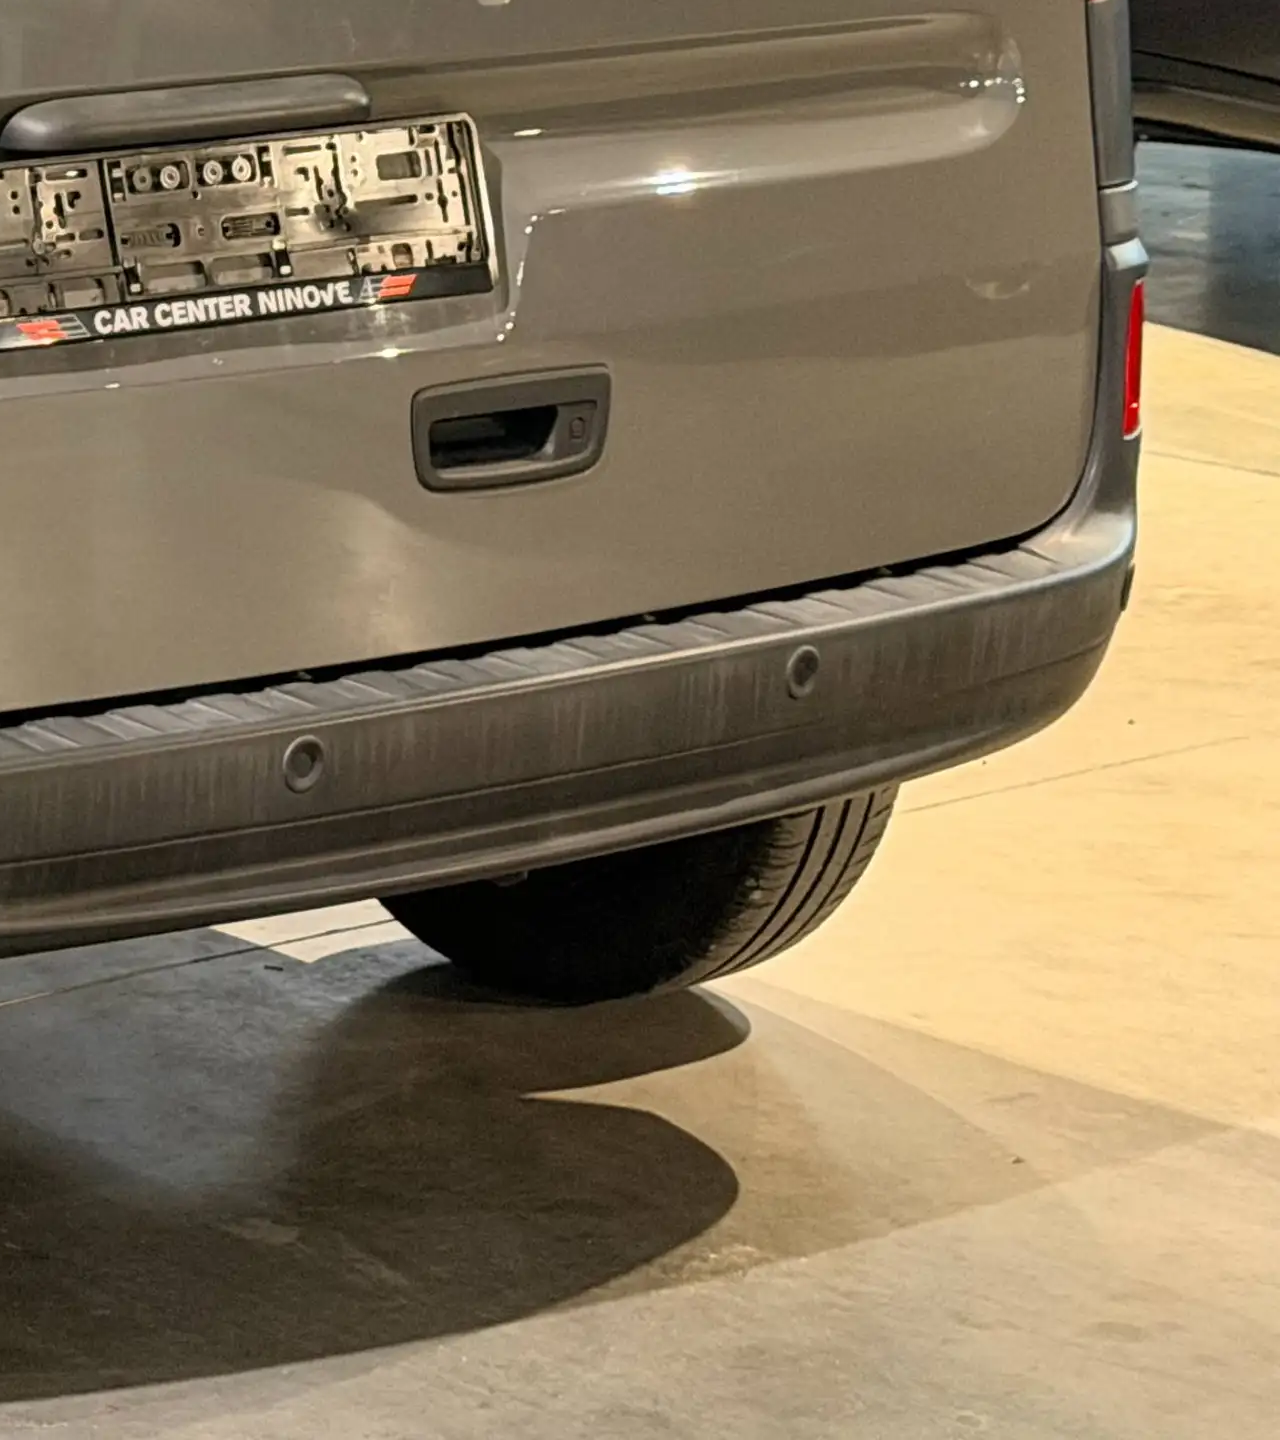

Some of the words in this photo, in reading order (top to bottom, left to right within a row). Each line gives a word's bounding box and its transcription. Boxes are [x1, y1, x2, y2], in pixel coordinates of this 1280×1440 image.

[93, 305, 151, 335] CAR
[153, 292, 254, 328] CENTER
[256, 280, 354, 315] NINOVE
